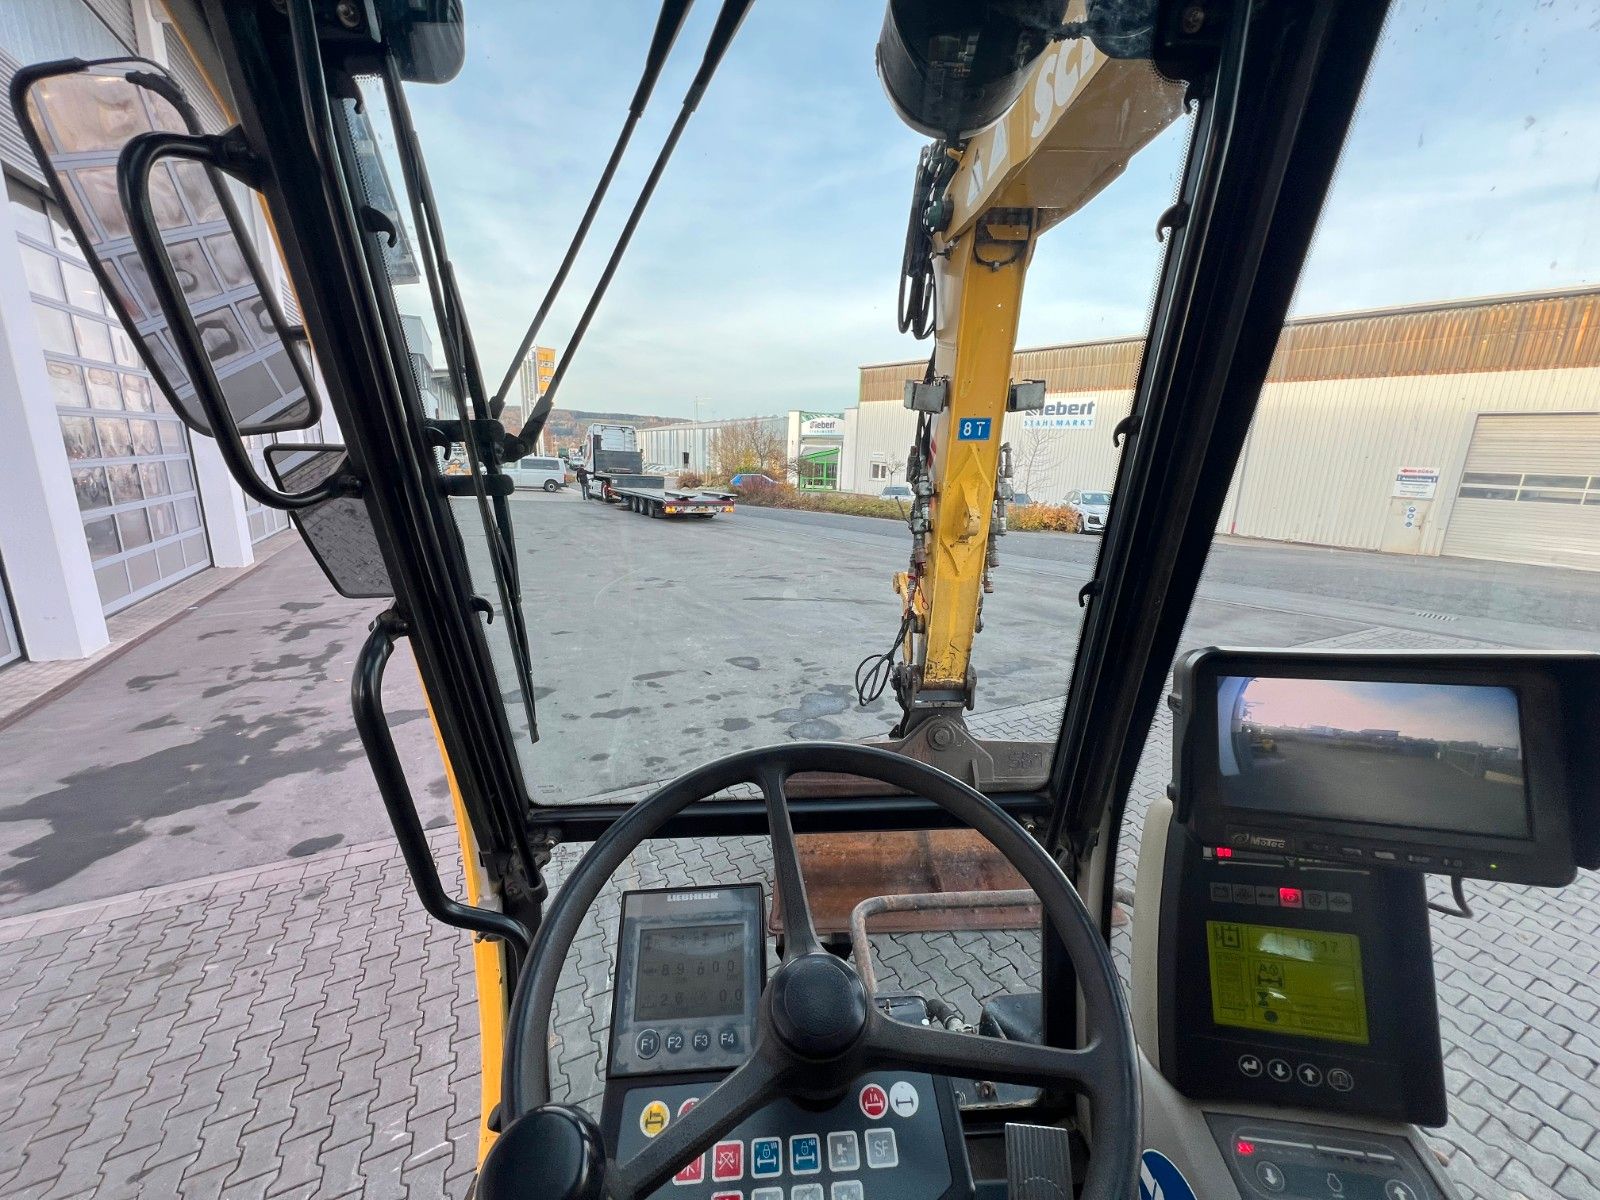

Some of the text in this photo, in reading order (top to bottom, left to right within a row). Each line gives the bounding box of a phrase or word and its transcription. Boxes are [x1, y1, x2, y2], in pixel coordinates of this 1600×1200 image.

[641, 1033, 734, 1051] F1 F2 F3 F4
[874, 1141, 889, 1158] SF
